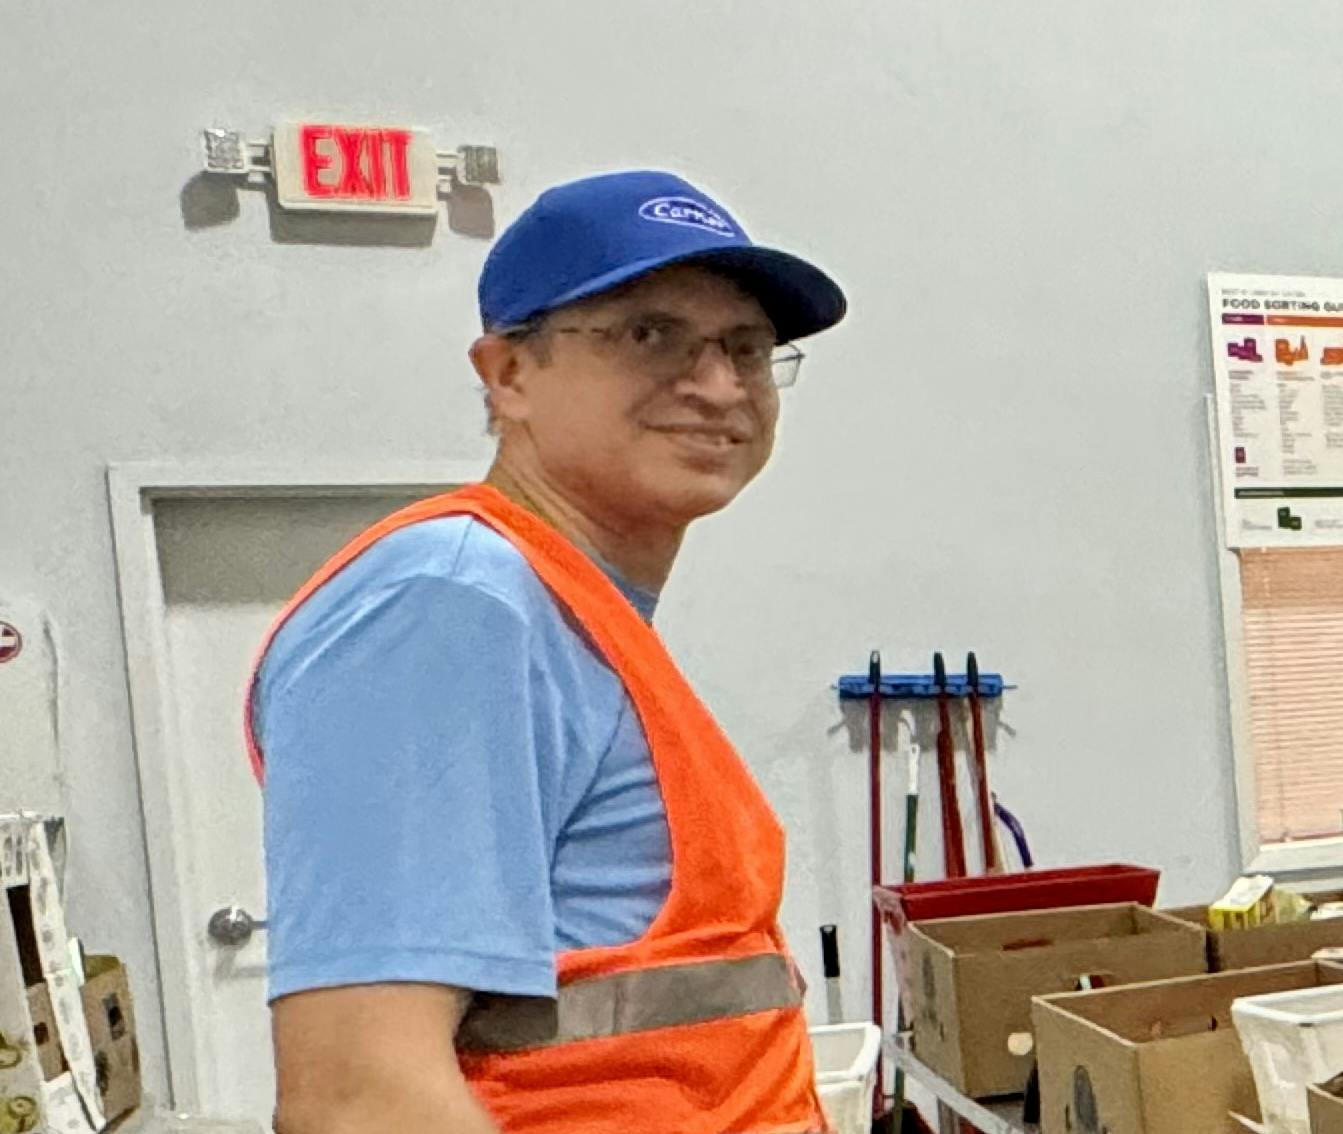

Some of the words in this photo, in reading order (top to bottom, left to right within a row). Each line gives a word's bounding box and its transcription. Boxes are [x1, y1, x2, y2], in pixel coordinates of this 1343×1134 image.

[299, 124, 411, 199] EXIT
[1221, 298, 1261, 310] FOOD
[1263, 300, 1321, 312] SORTING
